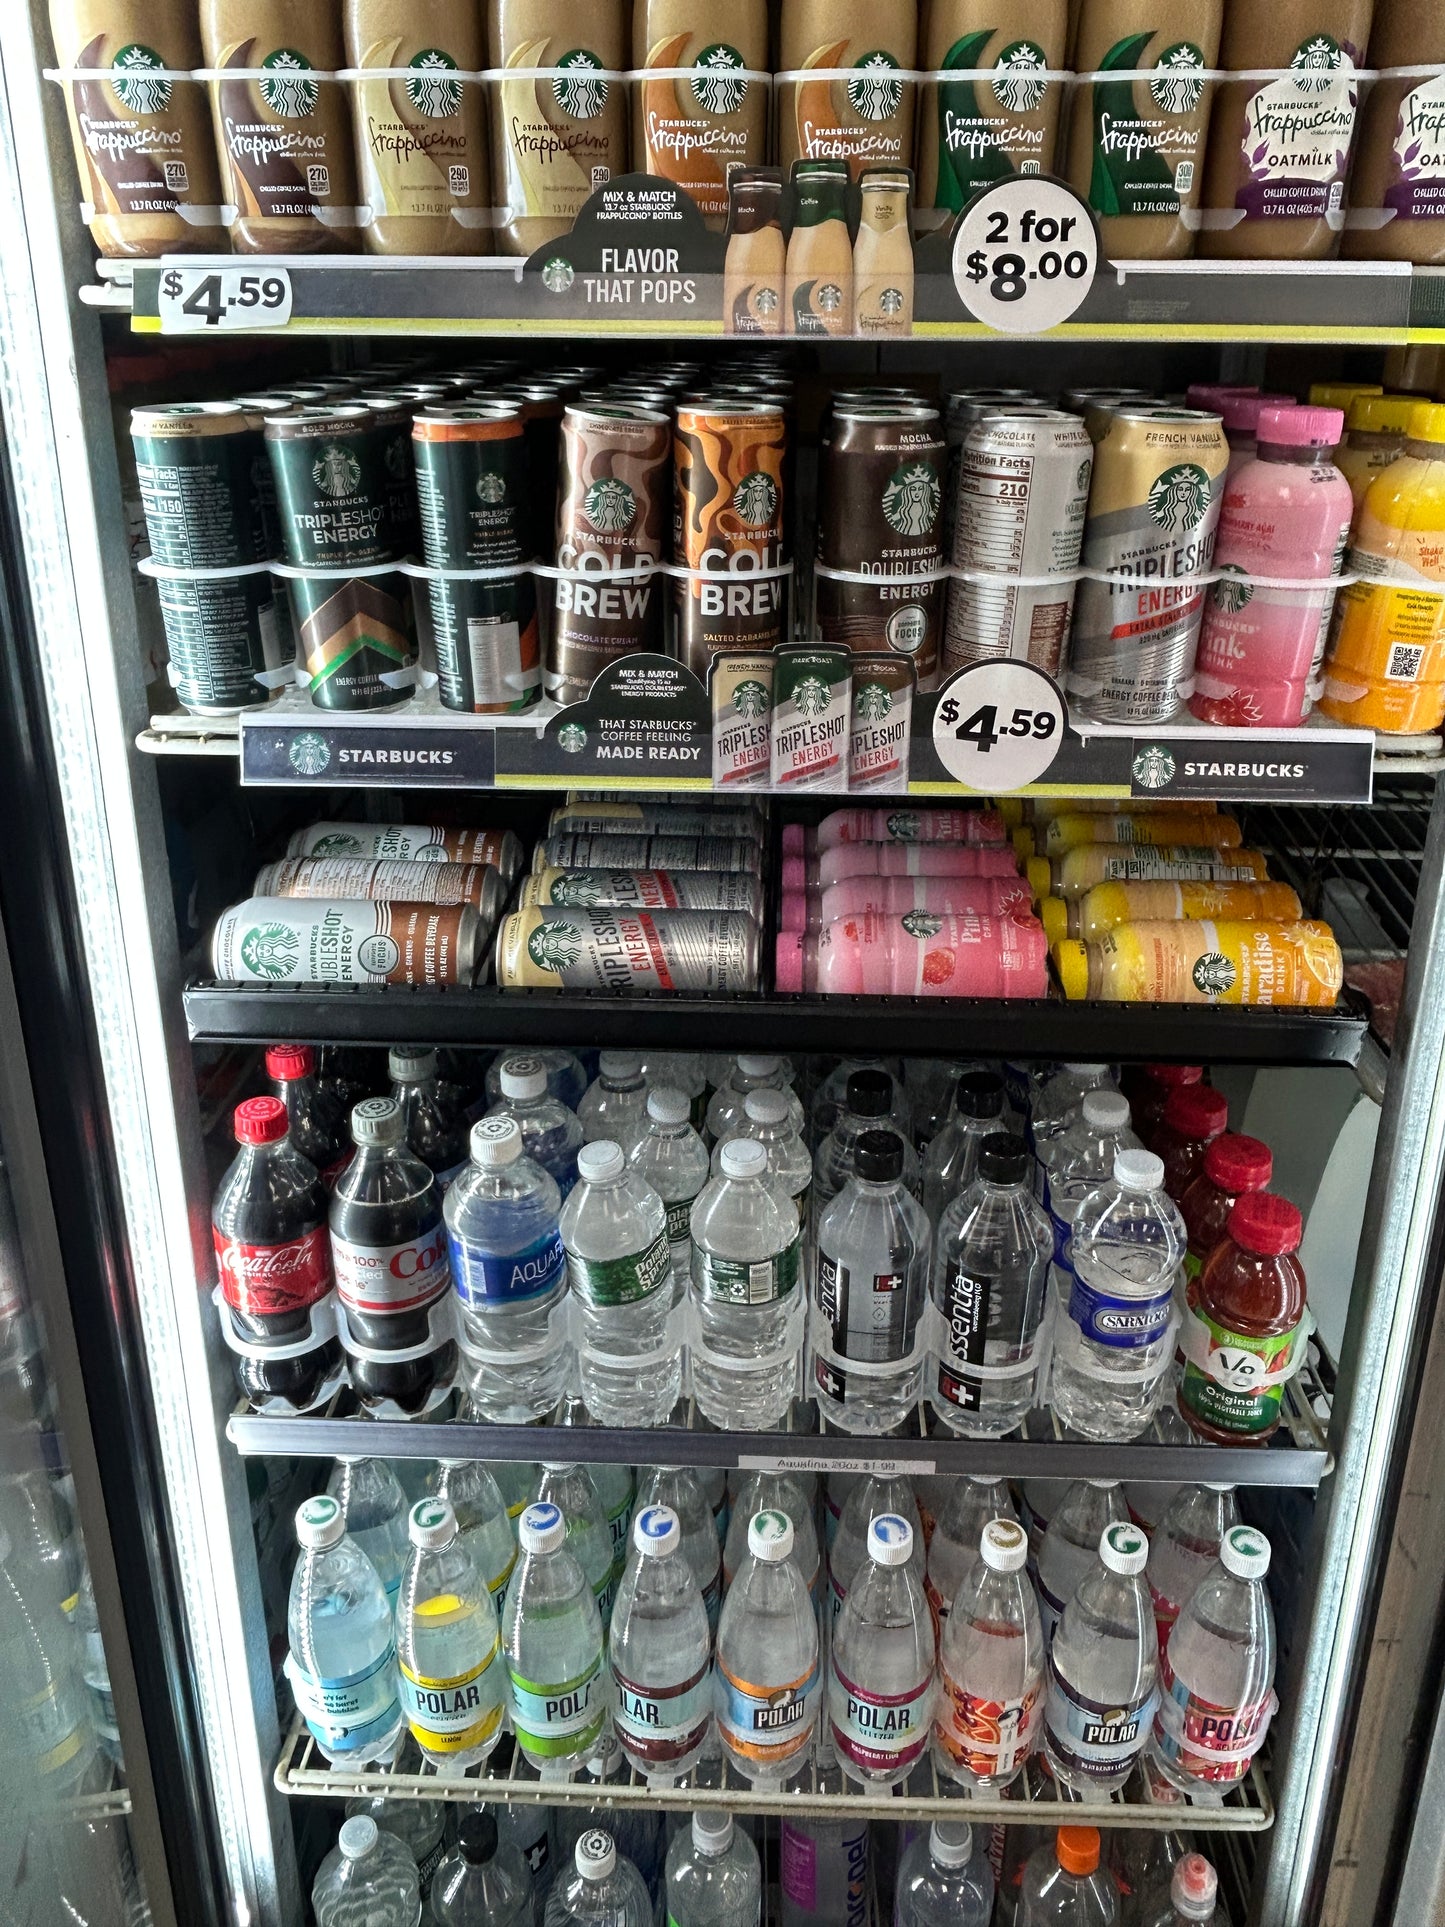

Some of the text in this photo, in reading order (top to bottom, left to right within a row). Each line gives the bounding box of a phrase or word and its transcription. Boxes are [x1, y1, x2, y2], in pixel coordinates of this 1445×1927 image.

[1267, 101, 1319, 110] STARBUCKS
[236, 124, 282, 133] STARBUCKS
[659, 119, 708, 127] STARBUCKS
[815, 128, 864, 136] STARBUCKS
[1112, 120, 1162, 128] STARBUCKS
[1268, 148, 1332, 167] OATMILK
[166, 163, 185, 176] 270
[309, 167, 327, 180] 270
[450, 167, 467, 180] 290
[593, 168, 608, 181] 290
[602, 191, 677, 202] MIX & MATCH
[986, 209, 1076, 243] 2 for
[601, 248, 679, 273] FLAVOR
[966, 250, 1088, 302] $8.00
[162, 270, 287, 326] $4.59
[583, 279, 697, 304] THAT POPS
[900, 433, 932, 443] MOCHA
[1145, 432, 1221, 444] FRENCH VANILLA
[999, 456, 1031, 468] Facts
[999, 483, 1028, 498] 210
[162, 500, 182, 513] 150
[313, 496, 369, 508] STARBUCKS
[312, 523, 378, 544] ENERGY
[573, 531, 640, 547] STARBUCKS
[724, 528, 779, 541] STARBUCK
[881, 544, 937, 558] STARBUCKS
[1121, 540, 1177, 560] STARBUCKS
[558, 544, 655, 586] COLD
[1106, 531, 1216, 596] TRIPLESHO
[555, 578, 651, 620] BREW
[879, 580, 935, 600] ENERGY
[703, 632, 734, 642] SALTED
[895, 627, 923, 639] FOCUS
[1206, 632, 1246, 660] ink
[619, 669, 679, 679] MIX & MATCH
[1101, 688, 1132, 701] ENERGY
[599, 719, 692, 731] THAT STARBUCKS
[775, 714, 846, 757] TRIPLESHOT
[938, 697, 1056, 753] $4.59
[601, 731, 692, 743] COFFEE FEELING
[717, 724, 771, 758] TRIPLESH
[851, 720, 906, 756] IPLESHOT
[338, 749, 454, 764] STARBUCKS
[596, 746, 702, 761] MADE READY
[791, 741, 834, 767] ENERGY
[853, 745, 894, 771] ENERGY
[1184, 762, 1305, 778] STARBUCKS
[310, 925, 320, 980] STARBUCKS
[323, 908, 344, 983] OUBLESHOT
[342, 925, 354, 982] ENERGY
[377, 940, 387, 969] FOCUS
[586, 907, 634, 988] RIPLESHO
[618, 918, 651, 971] ENERGY
[425, 949, 436, 974] COFFEE
[1253, 932, 1273, 1004] aradise
[1276, 956, 1286, 993] DRINK
[222, 1237, 316, 1273] Coca-Cola
[510, 1237, 564, 1289] AQUAF
[819, 1261, 836, 1322] entia
[951, 1274, 975, 1362] ssentia
[1206, 1386, 1258, 1407] Original
[415, 1685, 481, 1714] POLAR
[757, 1701, 803, 1729] POLAR
[847, 1698, 911, 1731] POLAR
[1087, 1724, 1137, 1743] POLAR
